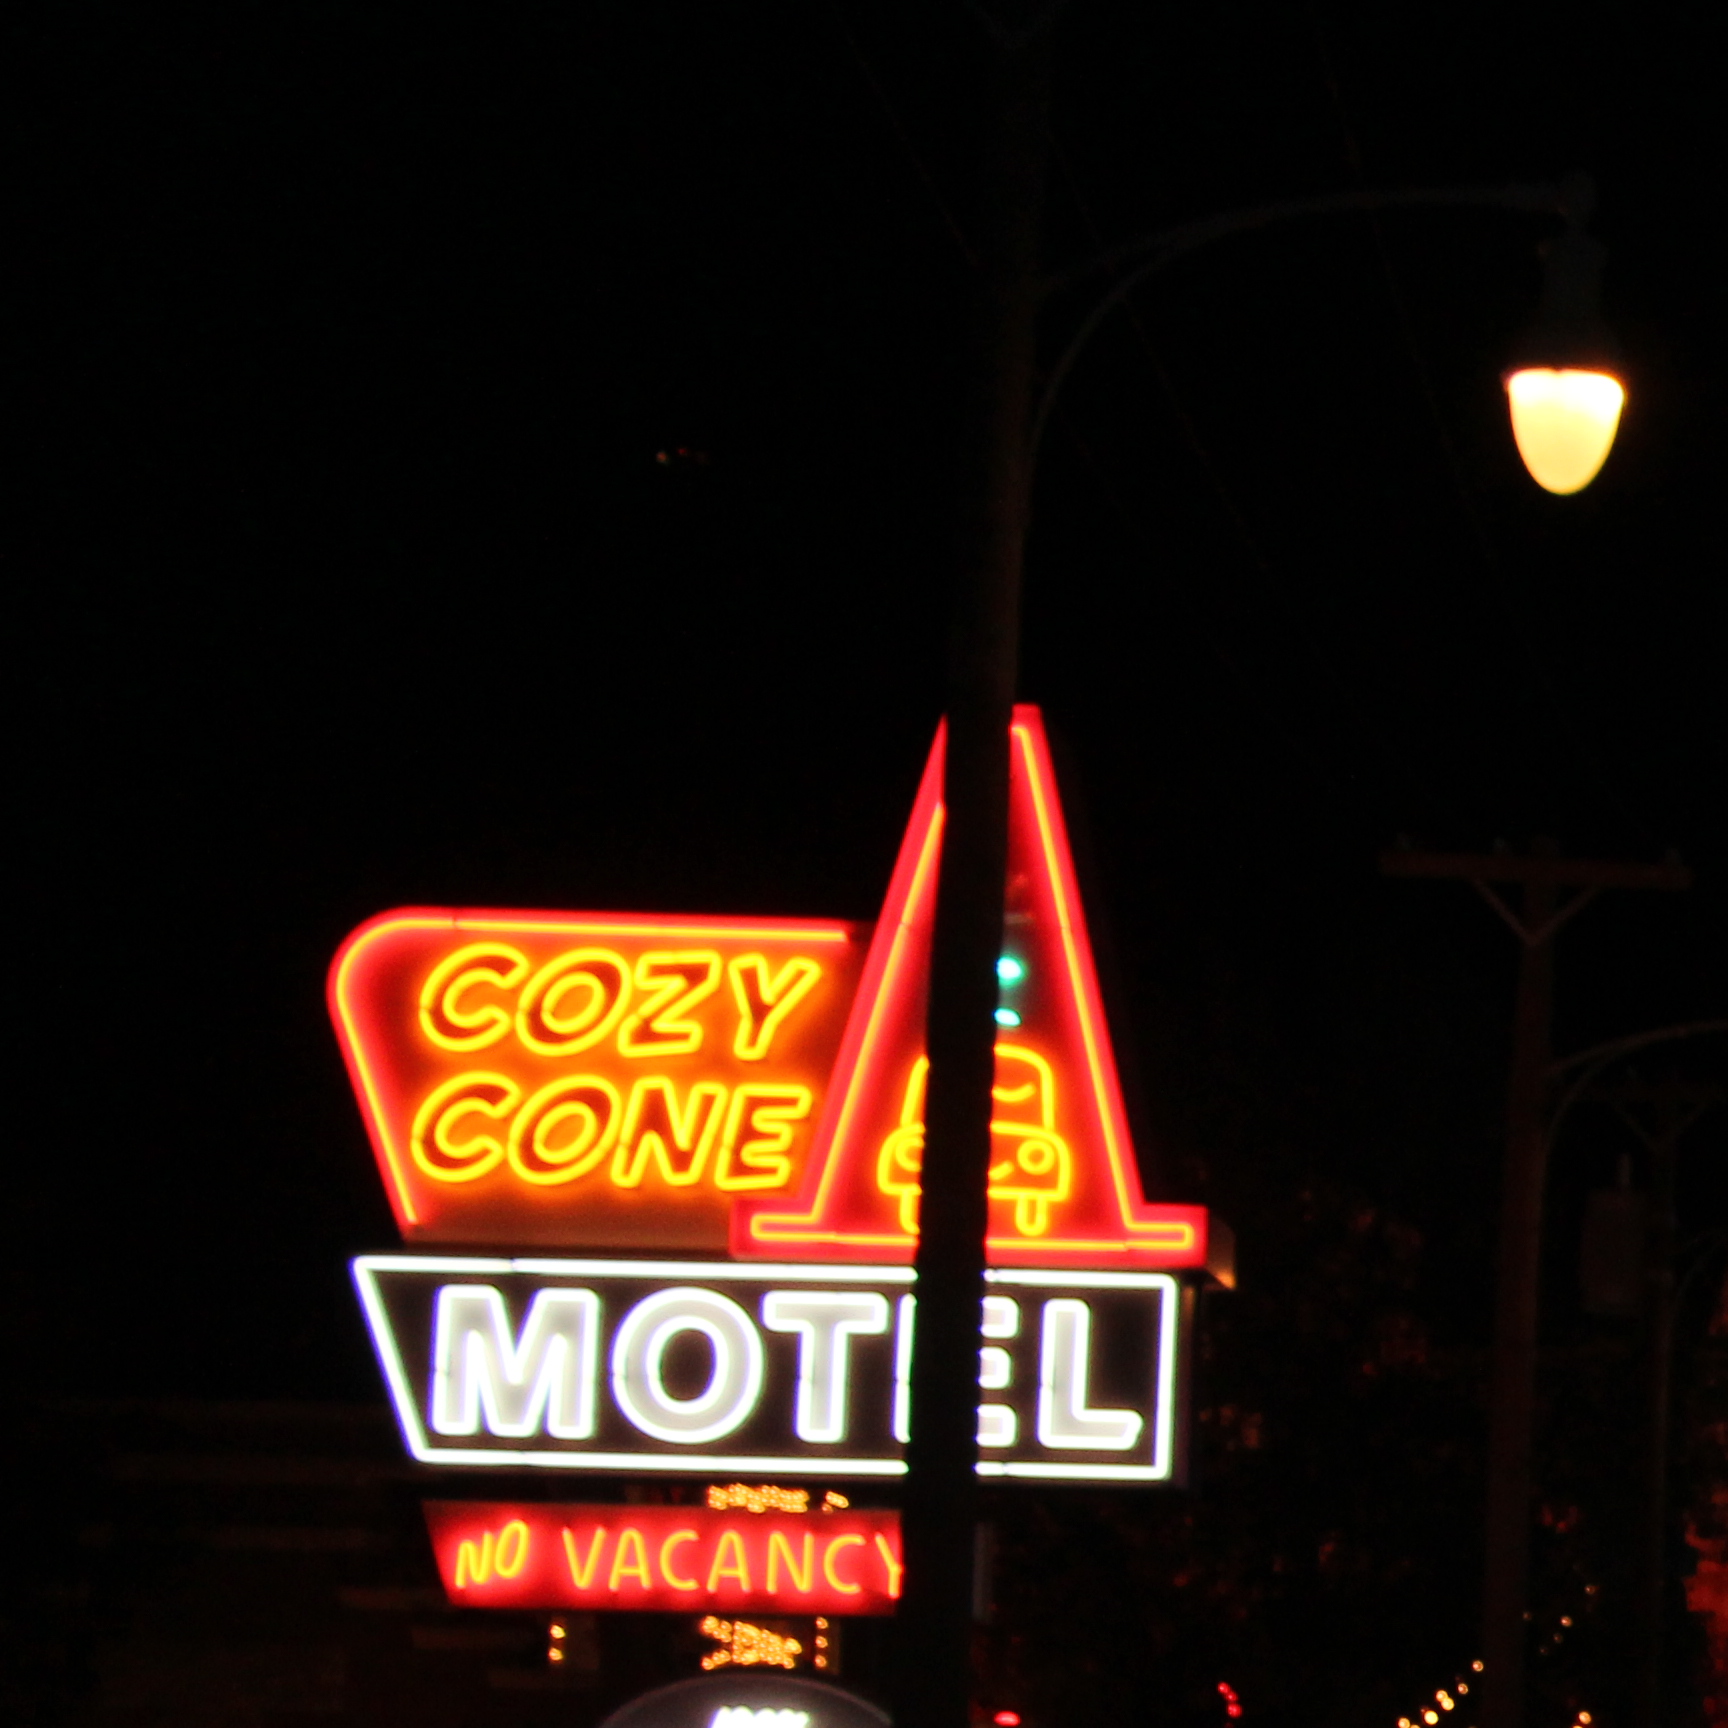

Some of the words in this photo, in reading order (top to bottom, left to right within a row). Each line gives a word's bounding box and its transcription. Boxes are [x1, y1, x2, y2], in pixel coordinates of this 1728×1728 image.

[418, 942, 821, 1061] COZY
[410, 1070, 814, 1193] CONE
[454, 1519, 531, 1590] NO
[562, 1525, 903, 1599] VACANCY
